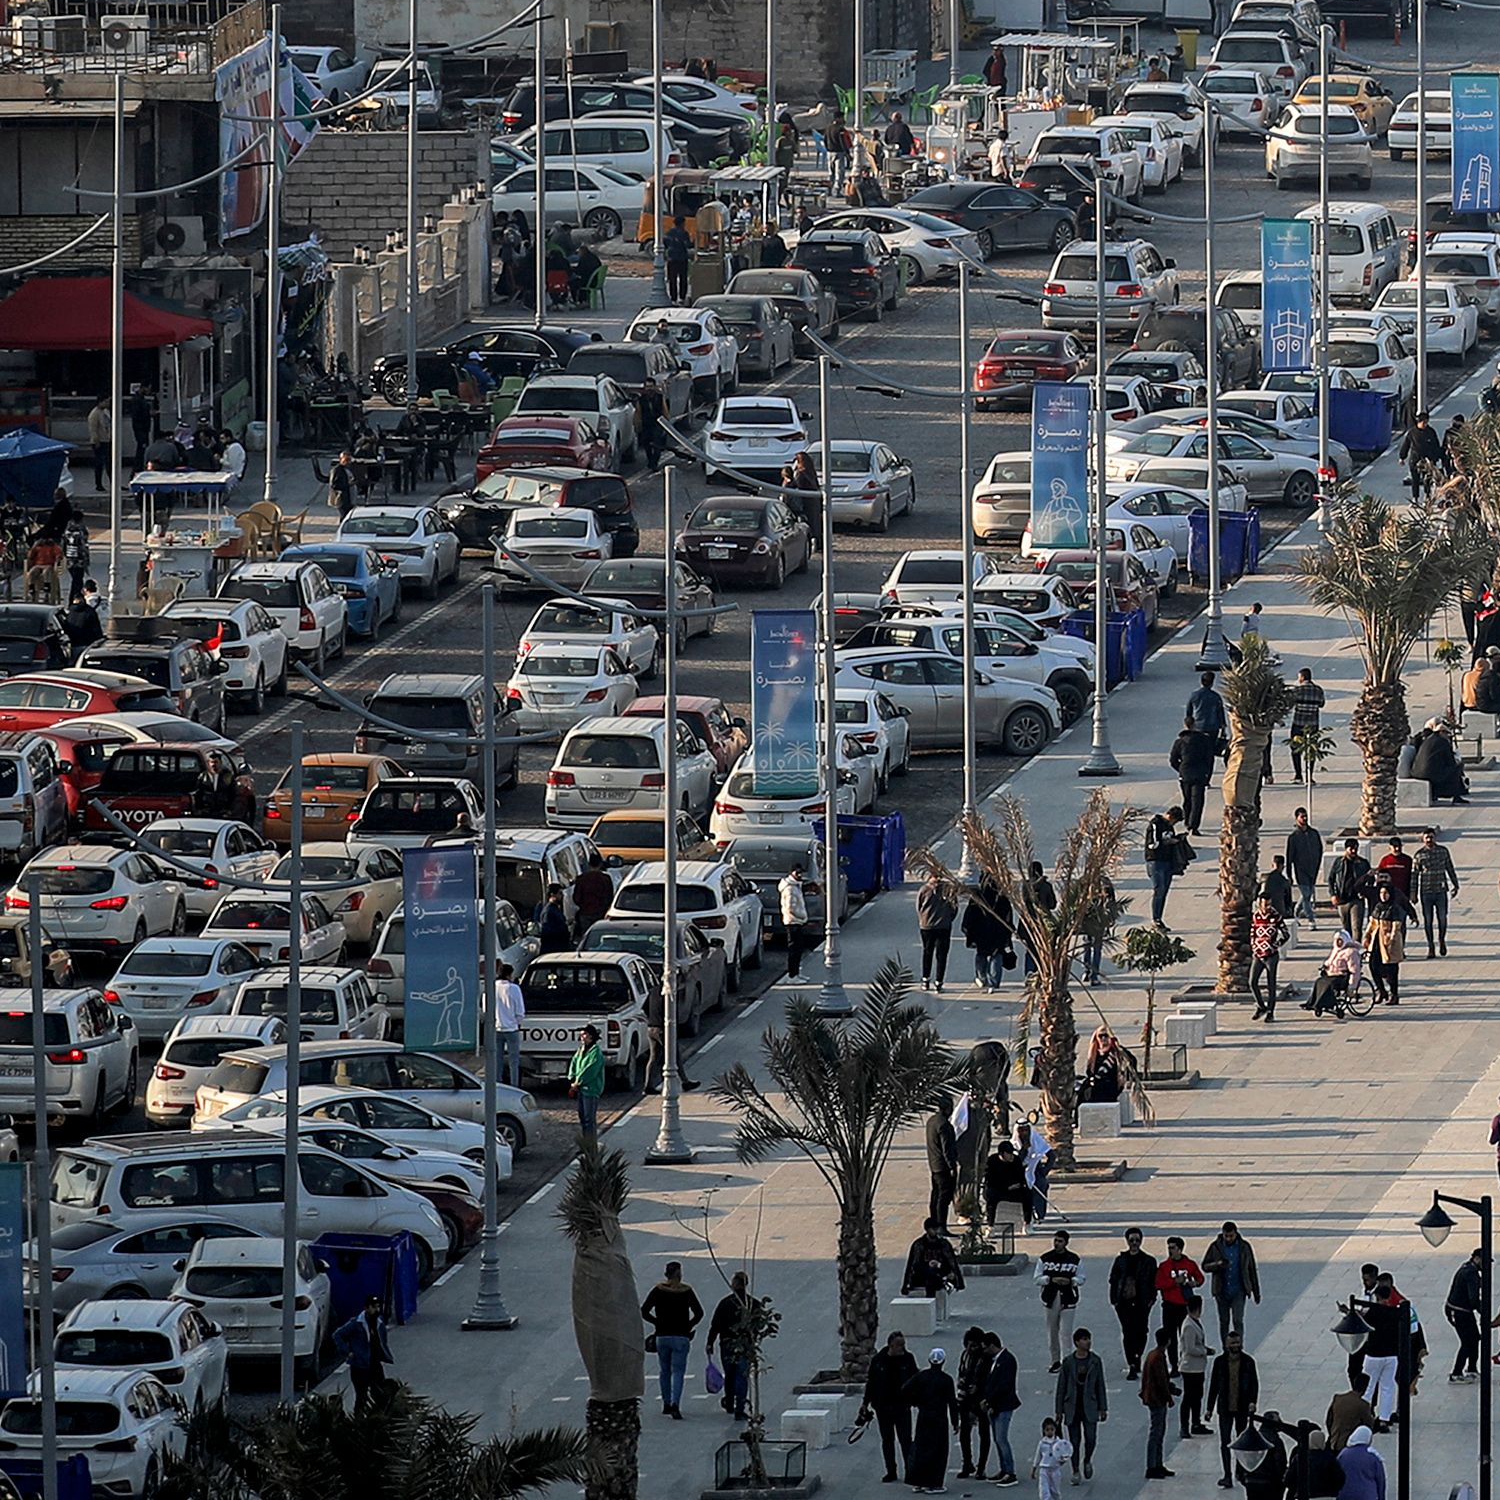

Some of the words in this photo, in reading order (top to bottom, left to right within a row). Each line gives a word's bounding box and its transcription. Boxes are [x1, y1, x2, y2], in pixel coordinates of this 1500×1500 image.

[1455, 107, 1494, 121] بصرة
[1267, 255, 1310, 271] بصرة
[1037, 423, 1082, 441] بصرة
[755, 671, 807, 690] بصرة
[106, 809, 166, 823] OYOTA
[411, 901, 469, 921] بصرة
[520, 1027, 583, 1042] TOYOT
